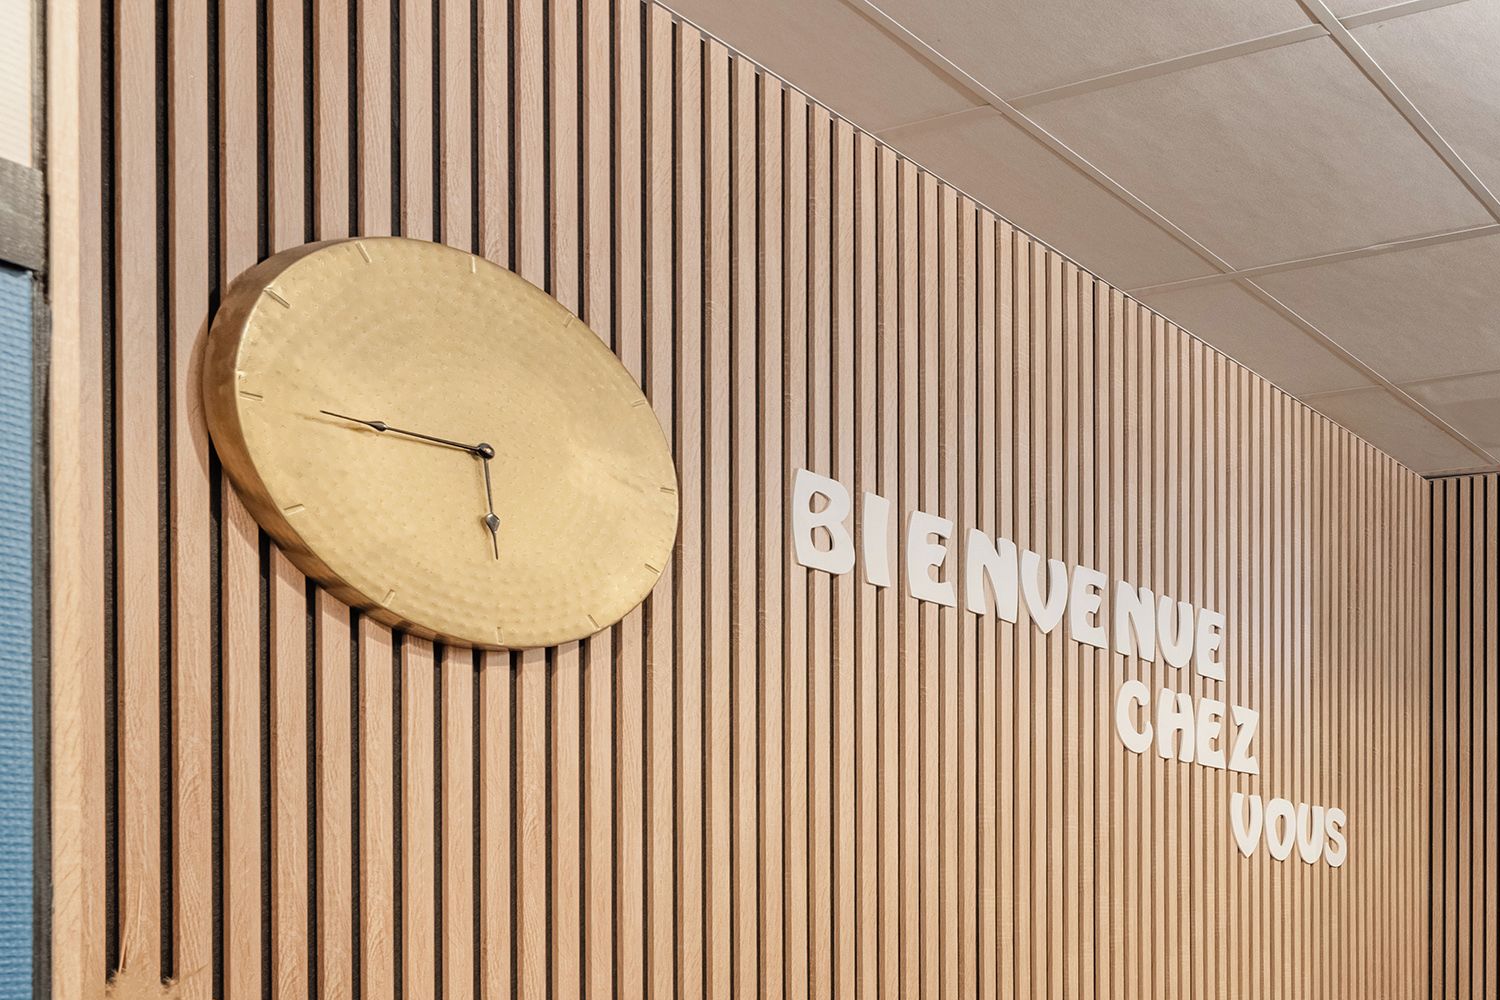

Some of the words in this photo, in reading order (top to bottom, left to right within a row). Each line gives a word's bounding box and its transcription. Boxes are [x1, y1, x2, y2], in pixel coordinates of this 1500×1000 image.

[793, 468, 1226, 682] BIENVENUE
[1116, 680, 1260, 775] CHEZ
[1230, 792, 1347, 867] VOUS
